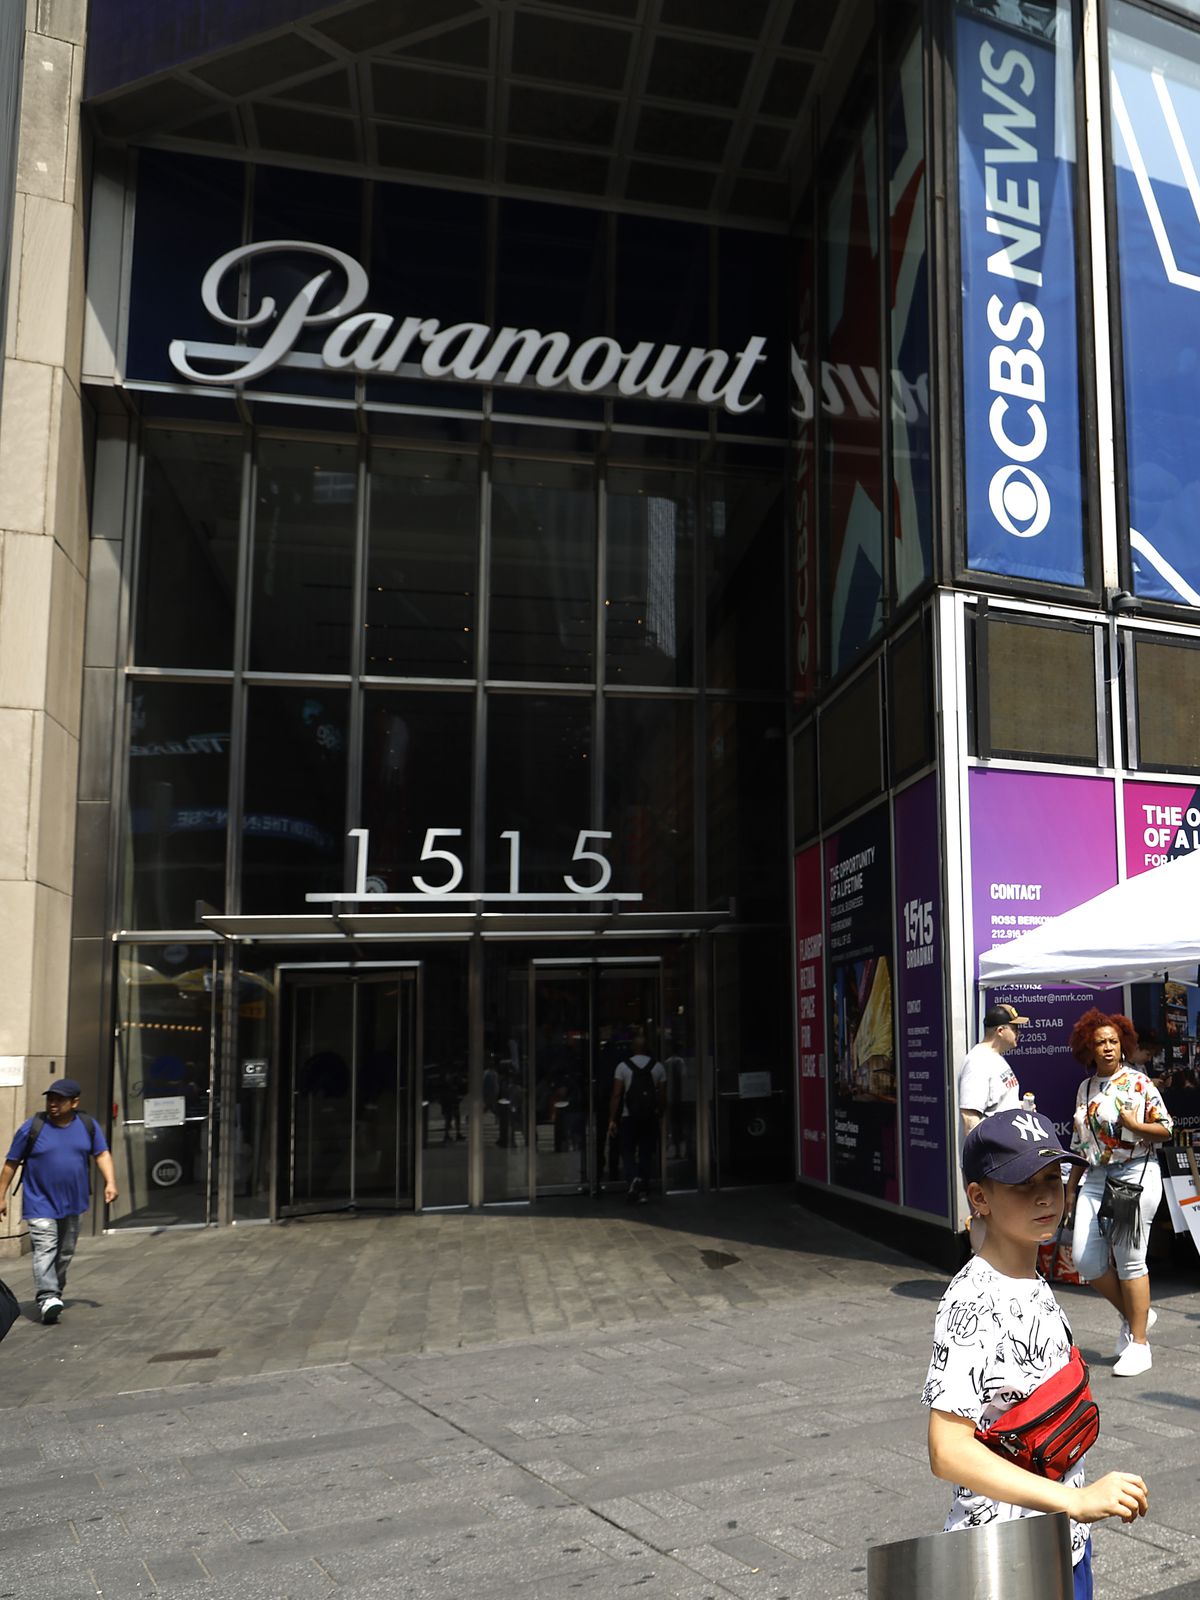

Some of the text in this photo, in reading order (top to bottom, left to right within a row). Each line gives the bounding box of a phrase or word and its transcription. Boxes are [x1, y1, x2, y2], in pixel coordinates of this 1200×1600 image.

[979, 40, 1048, 462] CBS NEWS
[169, 239, 768, 415] Paramount
[1142, 805, 1182, 825] THE
[1144, 828, 1171, 847] OF
[1175, 830, 1189, 849] A
[348, 828, 613, 895] 1515
[1145, 854, 1167, 866] FOR
[991, 884, 1042, 900] CONTACT
[991, 915, 1016, 925] ROSS
[906, 945, 933, 969] BROADWAY
[994, 993, 1093, 1004] ariel.schuster@nmrk.com
[1036, 1018, 1063, 1028] STAAB
